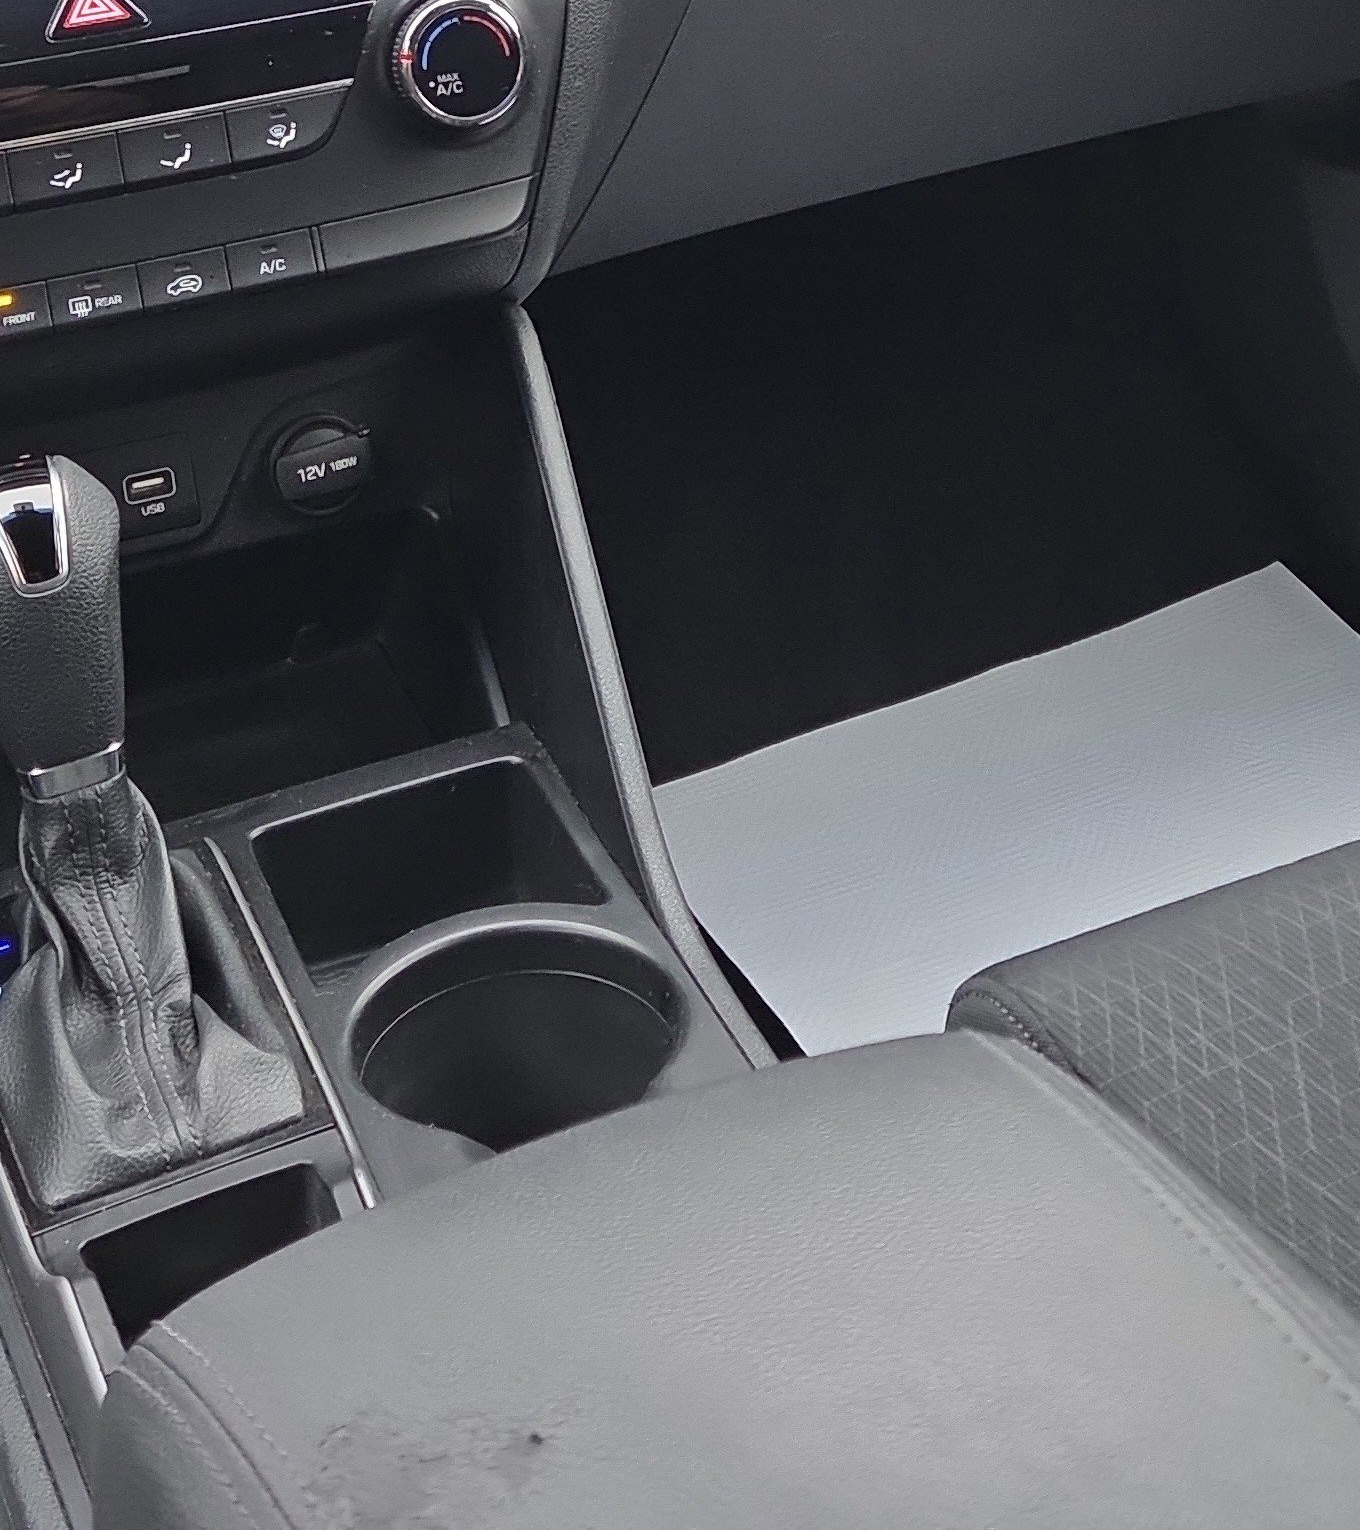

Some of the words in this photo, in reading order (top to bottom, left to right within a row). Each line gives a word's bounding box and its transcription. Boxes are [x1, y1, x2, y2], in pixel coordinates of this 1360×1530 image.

[436, 72, 460, 83] MAX
[436, 80, 464, 97] A/C
[259, 258, 287, 275] A/C
[95, 293, 122, 309] REAR
[2, 310, 37, 327] FRONT
[296, 461, 326, 483] 12V
[140, 502, 166, 516] USB
